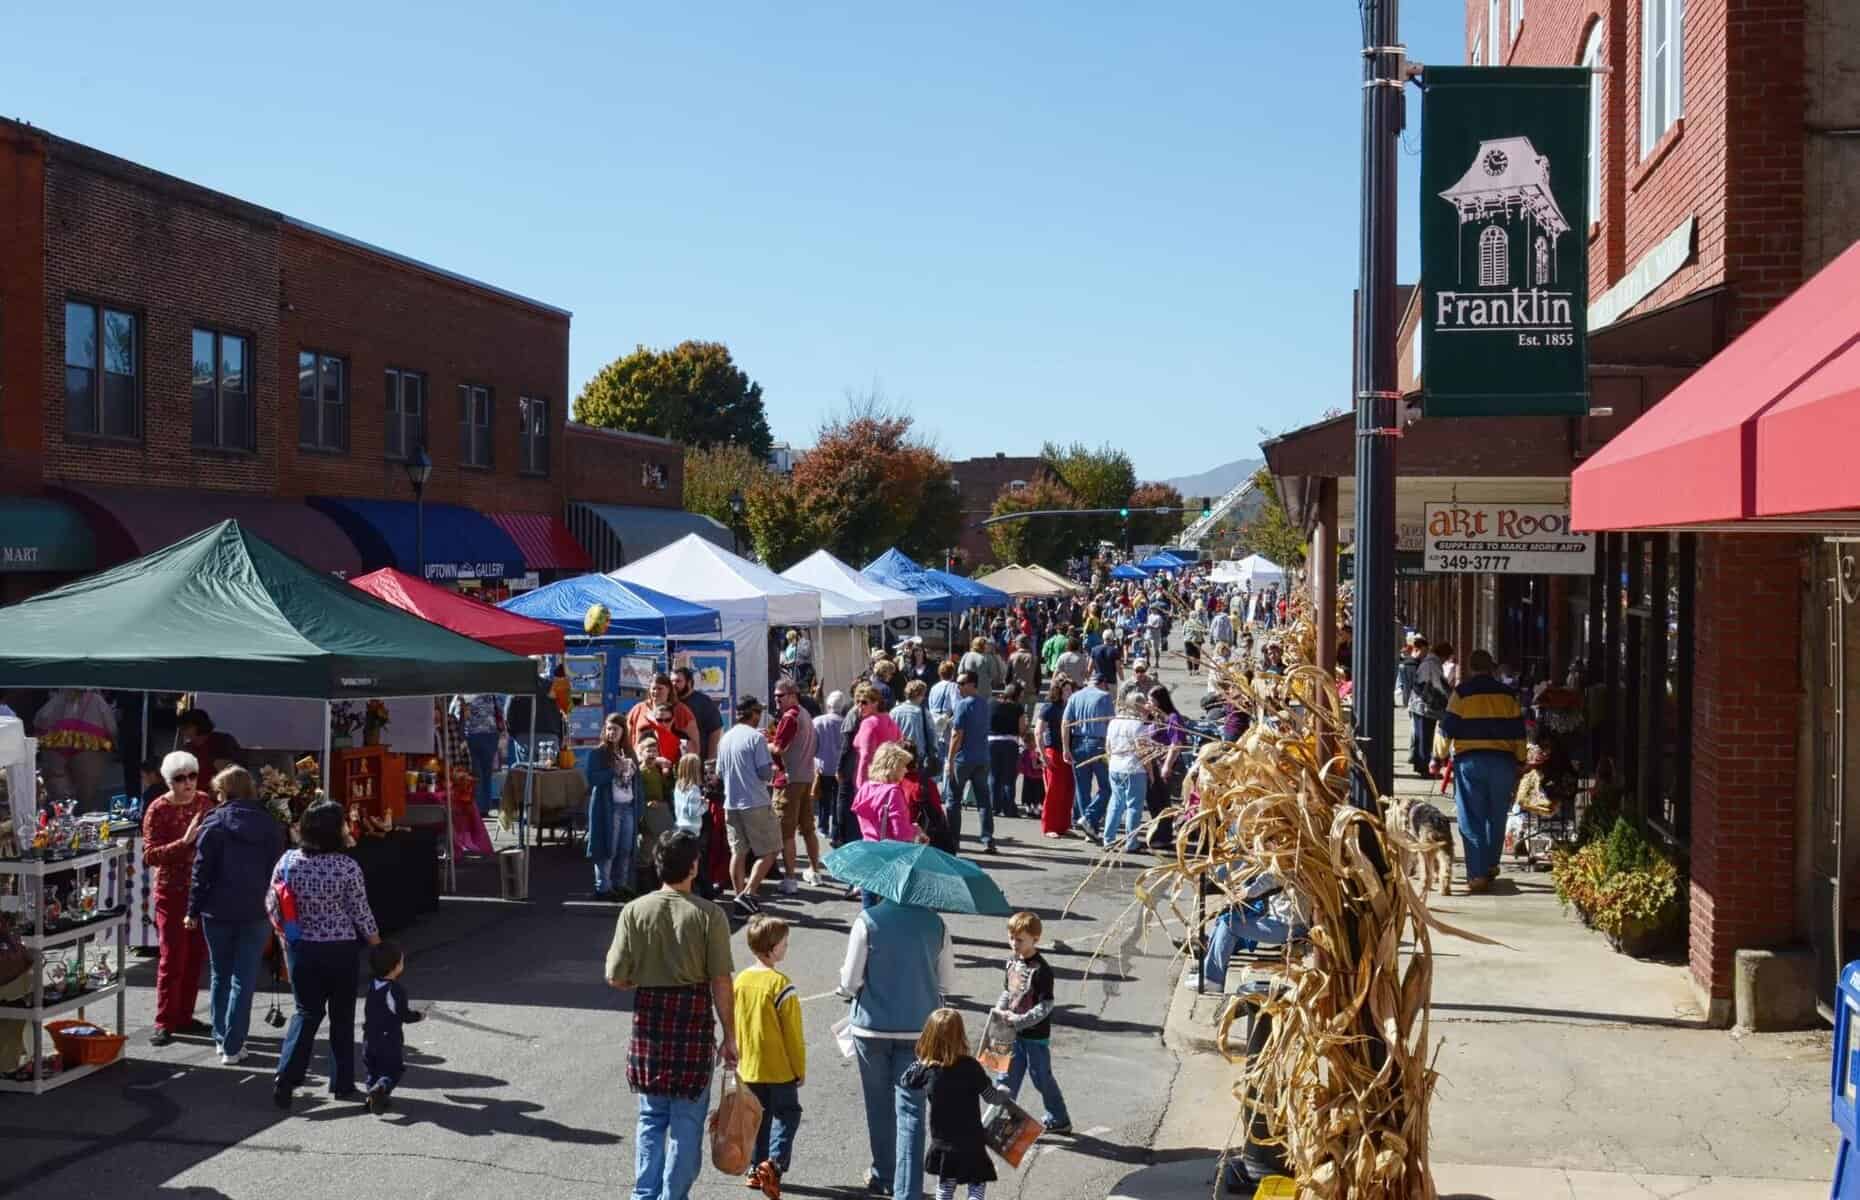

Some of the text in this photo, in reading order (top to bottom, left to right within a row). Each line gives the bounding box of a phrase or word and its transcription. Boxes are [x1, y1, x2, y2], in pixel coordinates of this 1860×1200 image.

[1436, 288, 1572, 325] Franklin
[1519, 333, 1573, 346] Est. 1855
[3, 546, 39, 561] MART
[1438, 542, 1483, 550] SUPPLIES
[1500, 543, 1529, 551] MAKE
[1530, 543, 1558, 551] MORE
[424, 562, 505, 578] UPTOWN GALLERY
[1440, 555, 1511, 570] 349-3777
